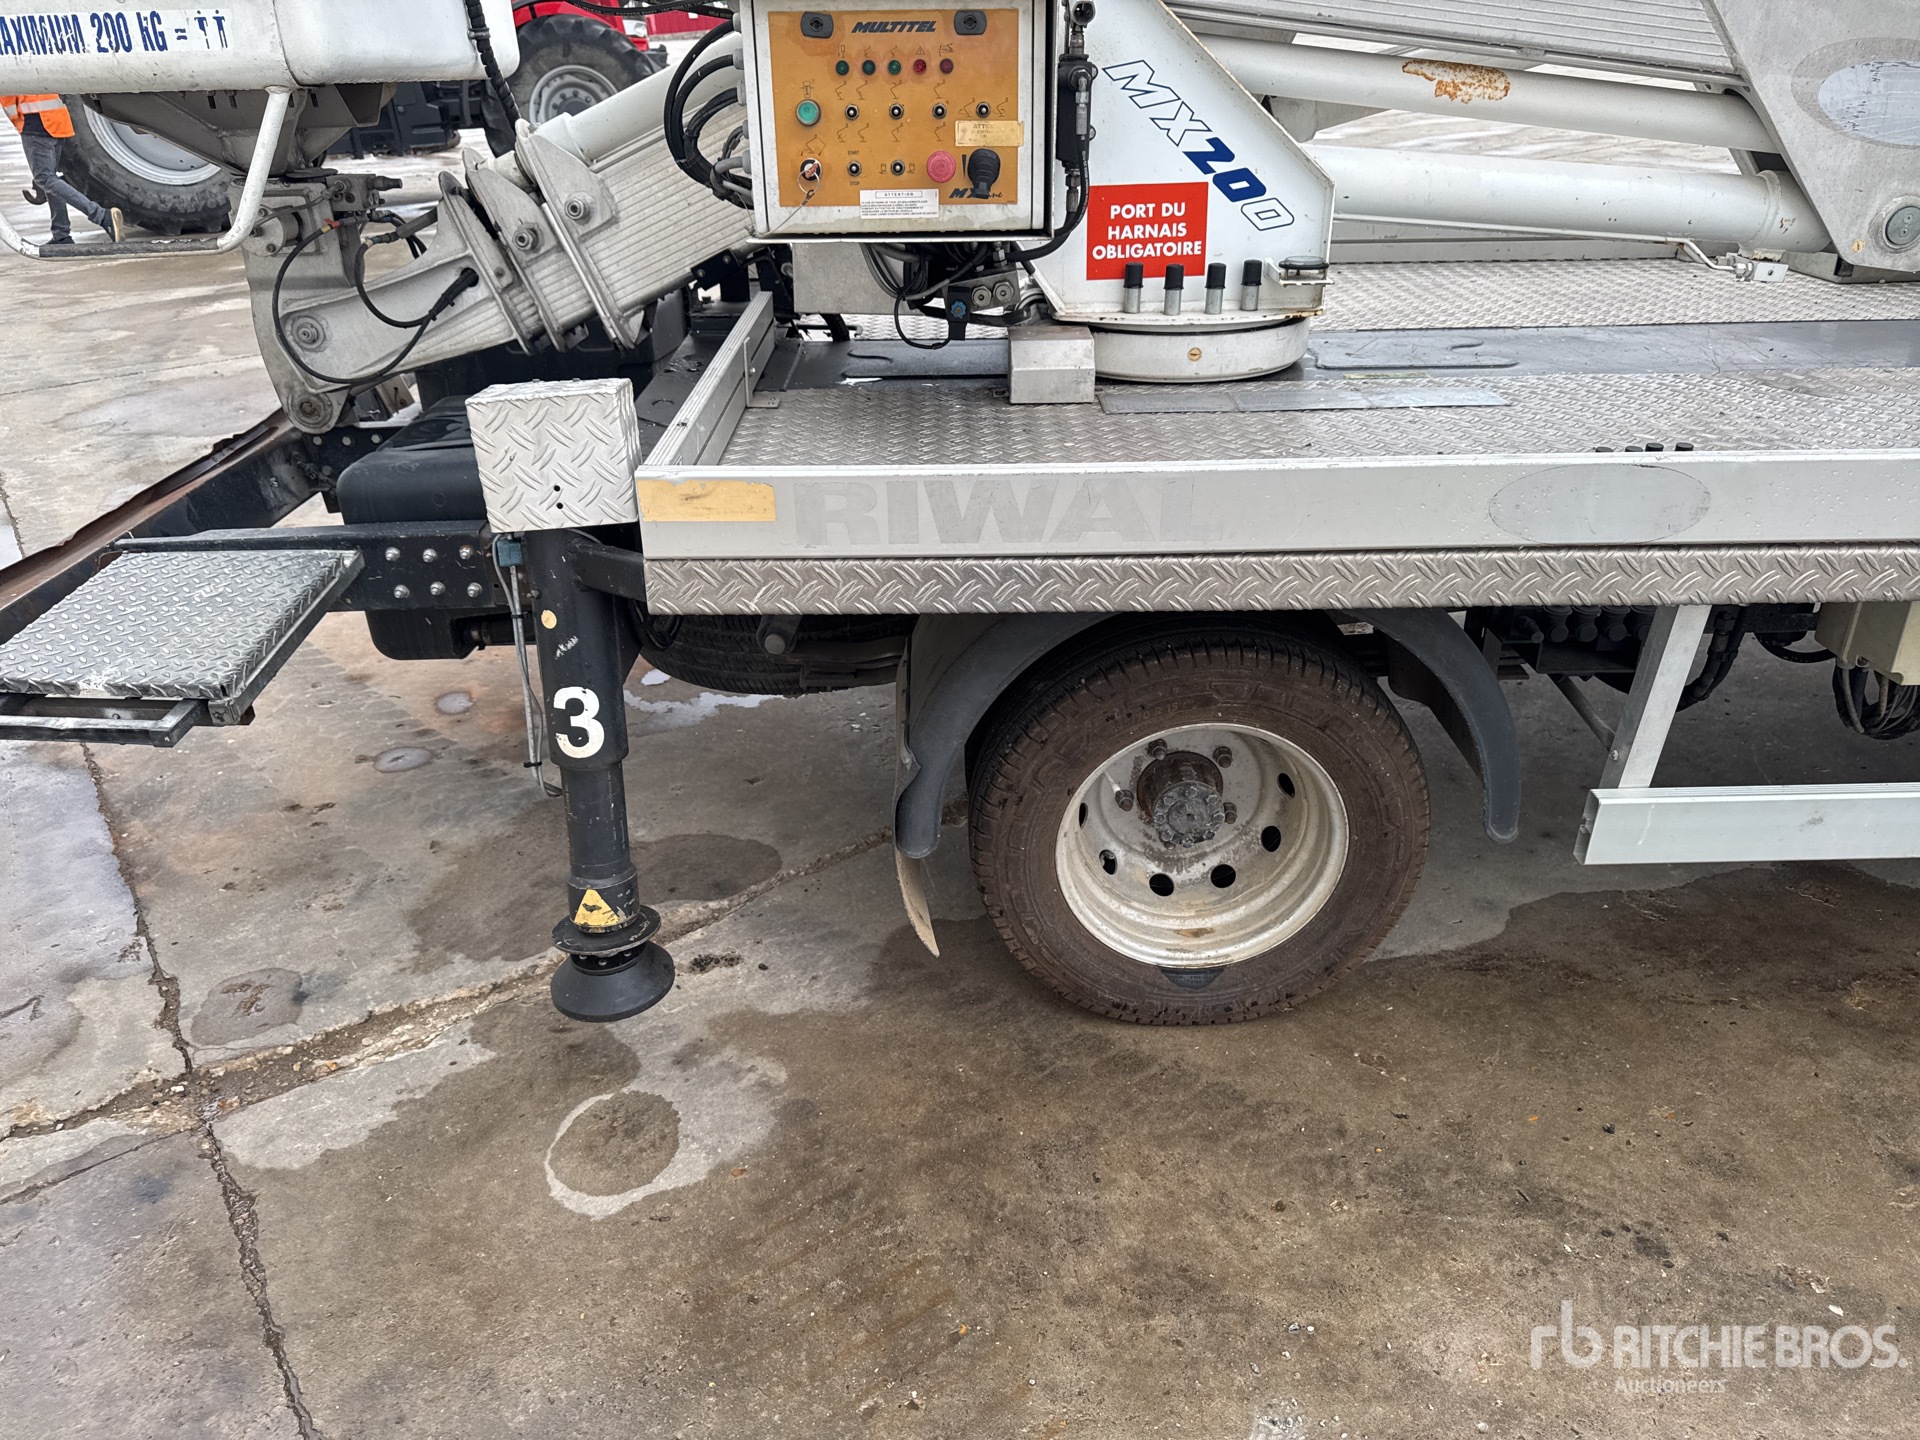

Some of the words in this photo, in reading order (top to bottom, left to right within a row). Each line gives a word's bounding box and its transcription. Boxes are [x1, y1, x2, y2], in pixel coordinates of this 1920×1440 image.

[0, 14, 86, 55] AXIMUM
[90, 12, 133, 53] 200
[136, 10, 168, 51] KG
[851, 20, 937, 33] MULTITEL
[1101, 59, 1295, 231] MX200
[1110, 203, 1155, 219] PORT
[1161, 202, 1186, 217] DU
[1108, 223, 1187, 240] HARNAIS
[1092, 241, 1202, 260] OBLIGATOIRE
[792, 477, 1223, 546] RIWAL
[553, 686, 605, 759] 3
